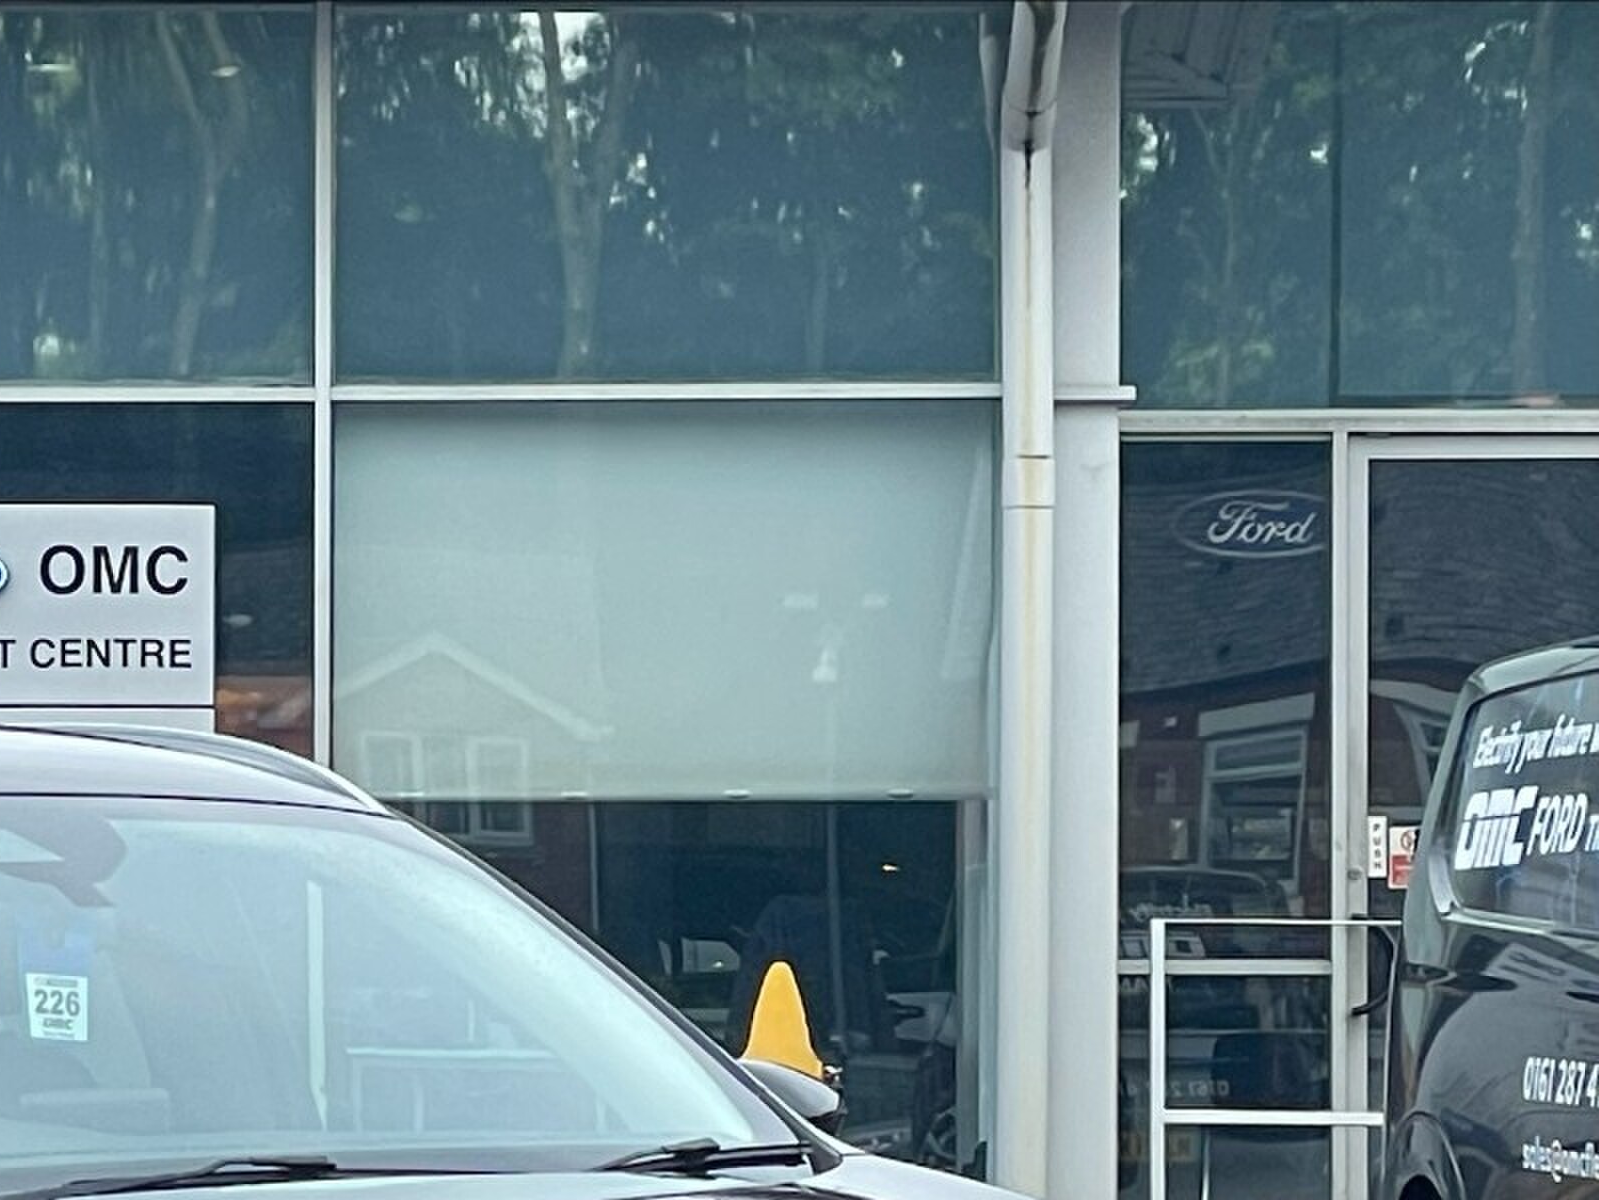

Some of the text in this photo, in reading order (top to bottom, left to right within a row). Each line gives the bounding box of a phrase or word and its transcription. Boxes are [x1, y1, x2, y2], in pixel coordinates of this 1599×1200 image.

[1207, 501, 1317, 544] Ford
[40, 544, 189, 596] OMC
[30, 638, 192, 669] CENTRE
[1515, 729, 1554, 774] your
[1454, 785, 1539, 870] OMC
[1526, 793, 1589, 856] FORD
[34, 989, 81, 1017] 226
[1523, 1056, 1555, 1102] 0161
[1555, 1058, 1586, 1106] 287
